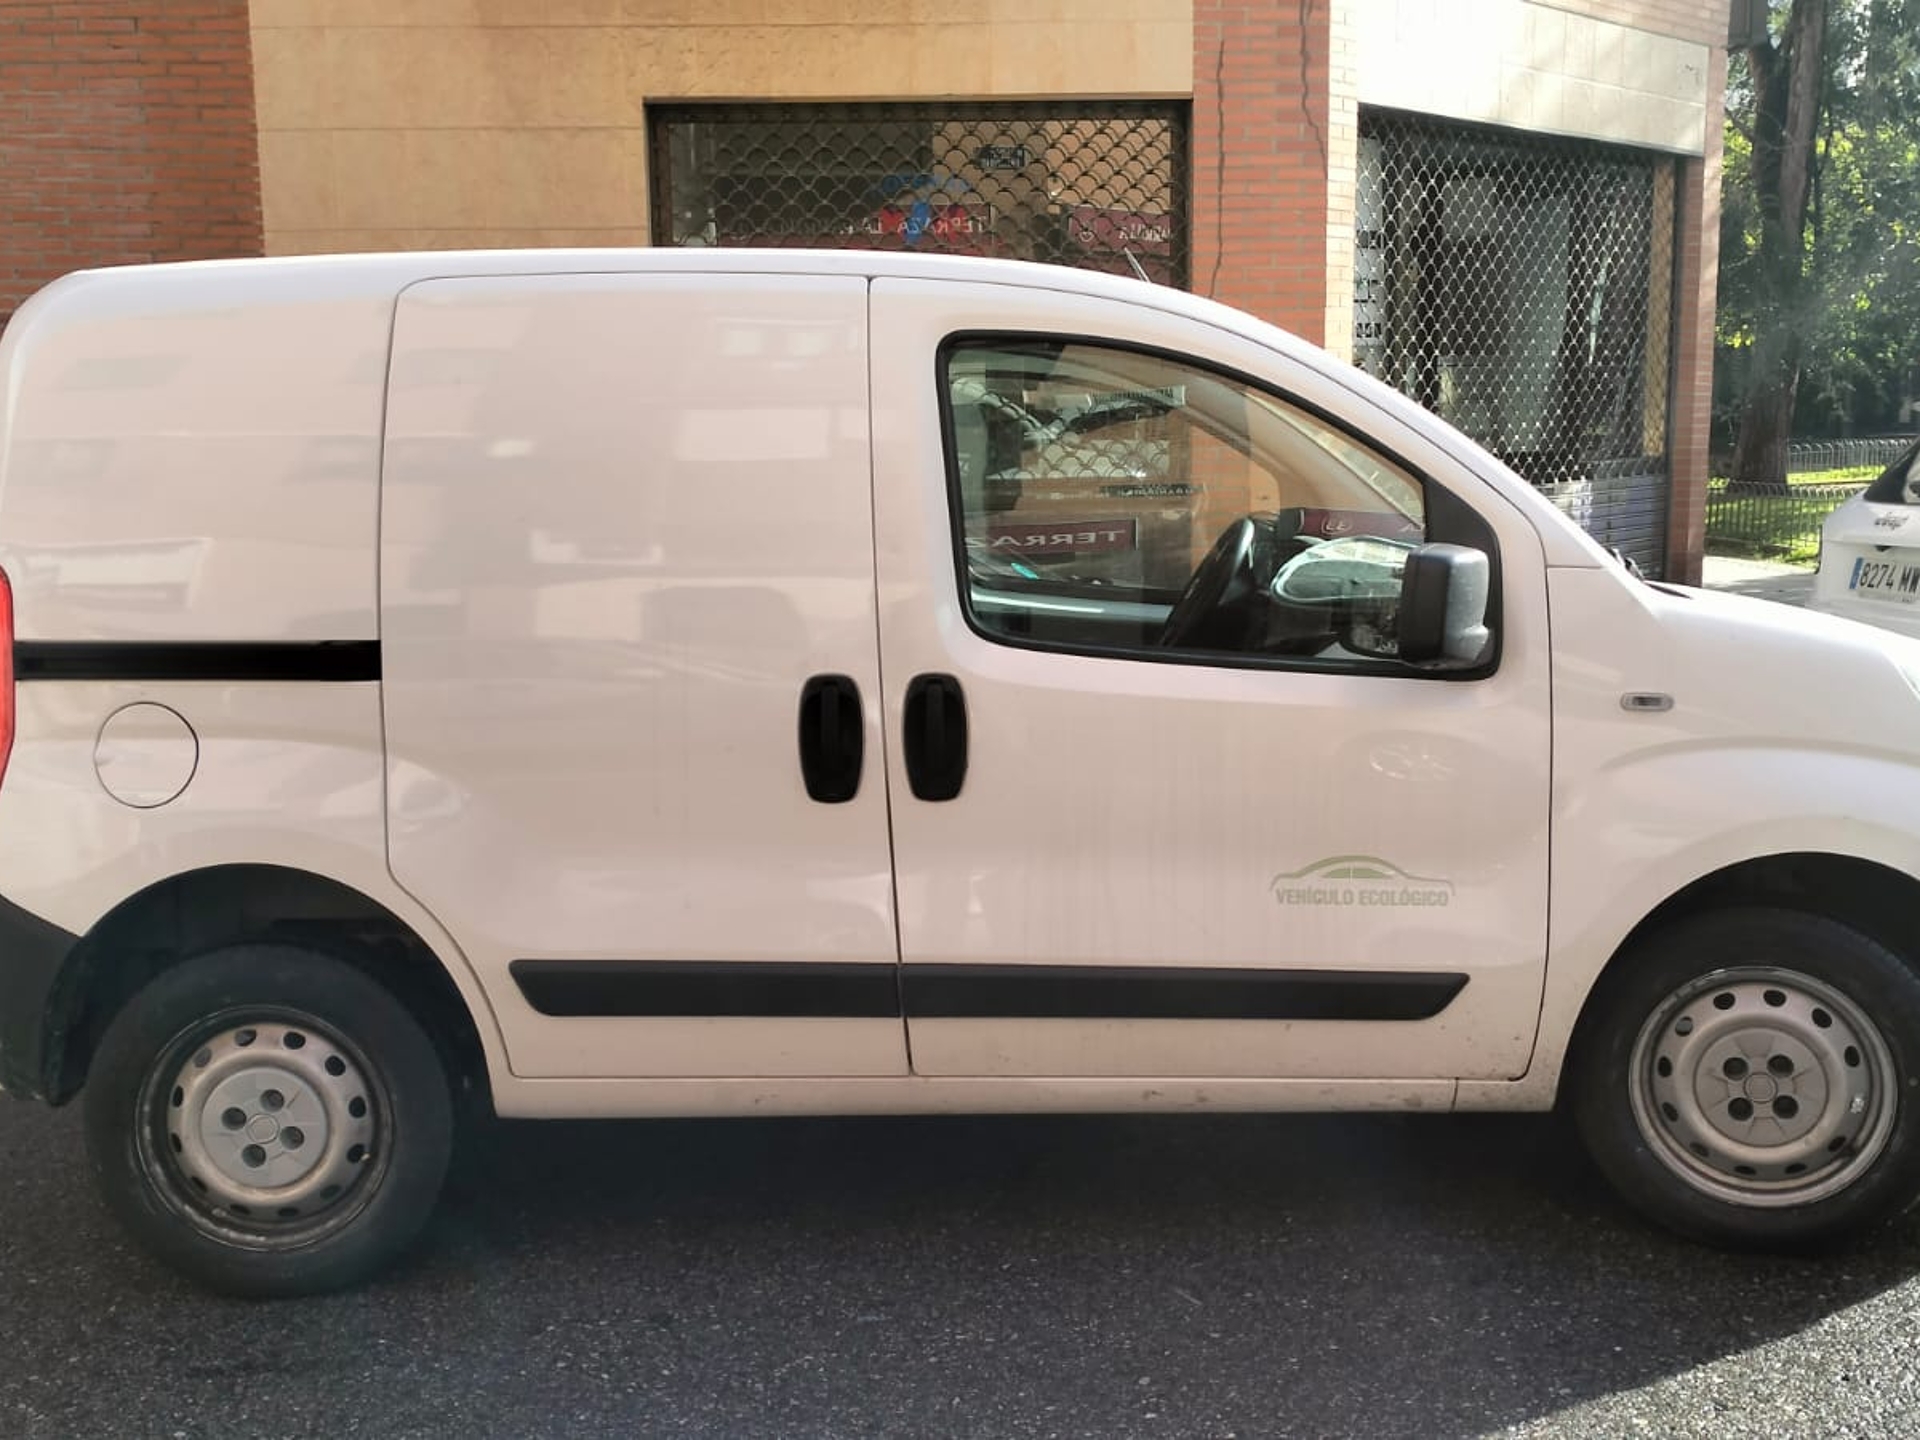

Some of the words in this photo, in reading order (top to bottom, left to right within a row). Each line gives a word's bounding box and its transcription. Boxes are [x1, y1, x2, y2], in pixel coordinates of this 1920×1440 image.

[1859, 562, 1897, 589] 8274
[1275, 886, 1355, 905] VEHÍCULO
[1358, 886, 1449, 907] ECOLÓGICO
